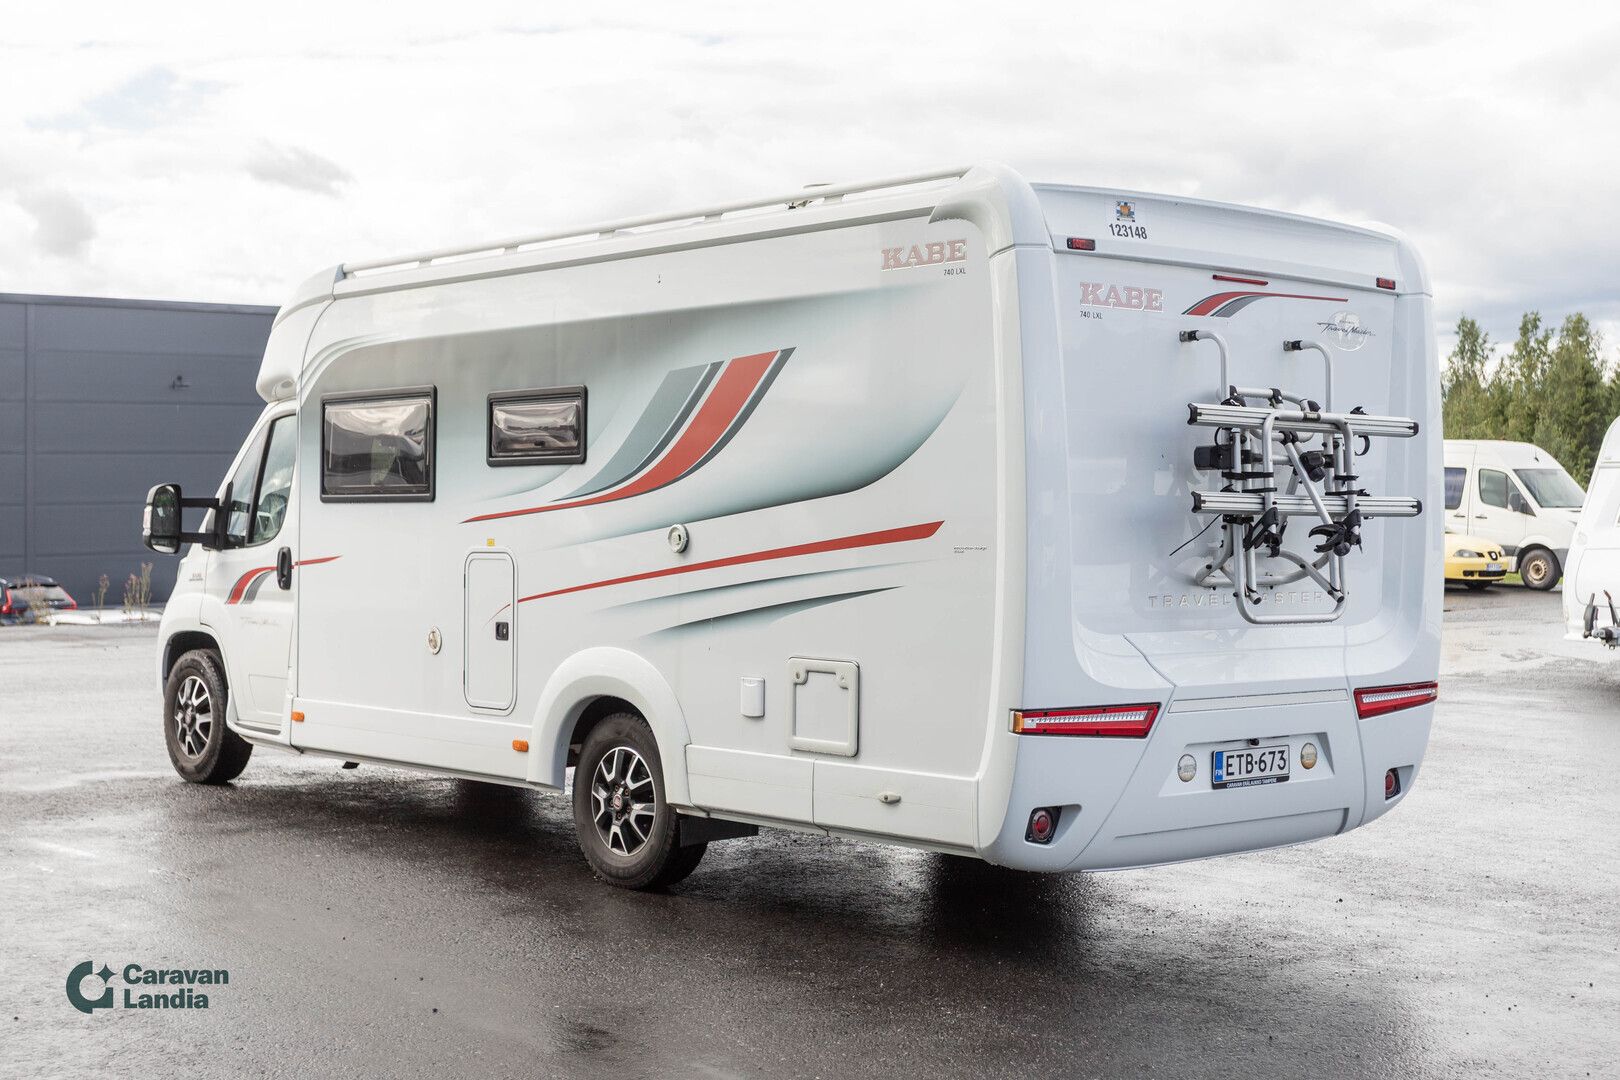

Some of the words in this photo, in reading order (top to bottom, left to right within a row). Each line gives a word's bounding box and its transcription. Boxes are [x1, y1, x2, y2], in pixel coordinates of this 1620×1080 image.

[1109, 223, 1148, 239] 123148
[881, 239, 967, 271] KABE
[1080, 281, 1163, 312] KABE
[1080, 311, 1091, 319] 740
[1148, 593, 1231, 608] TRAVEL
[1226, 750, 1287, 776] ETB-673
